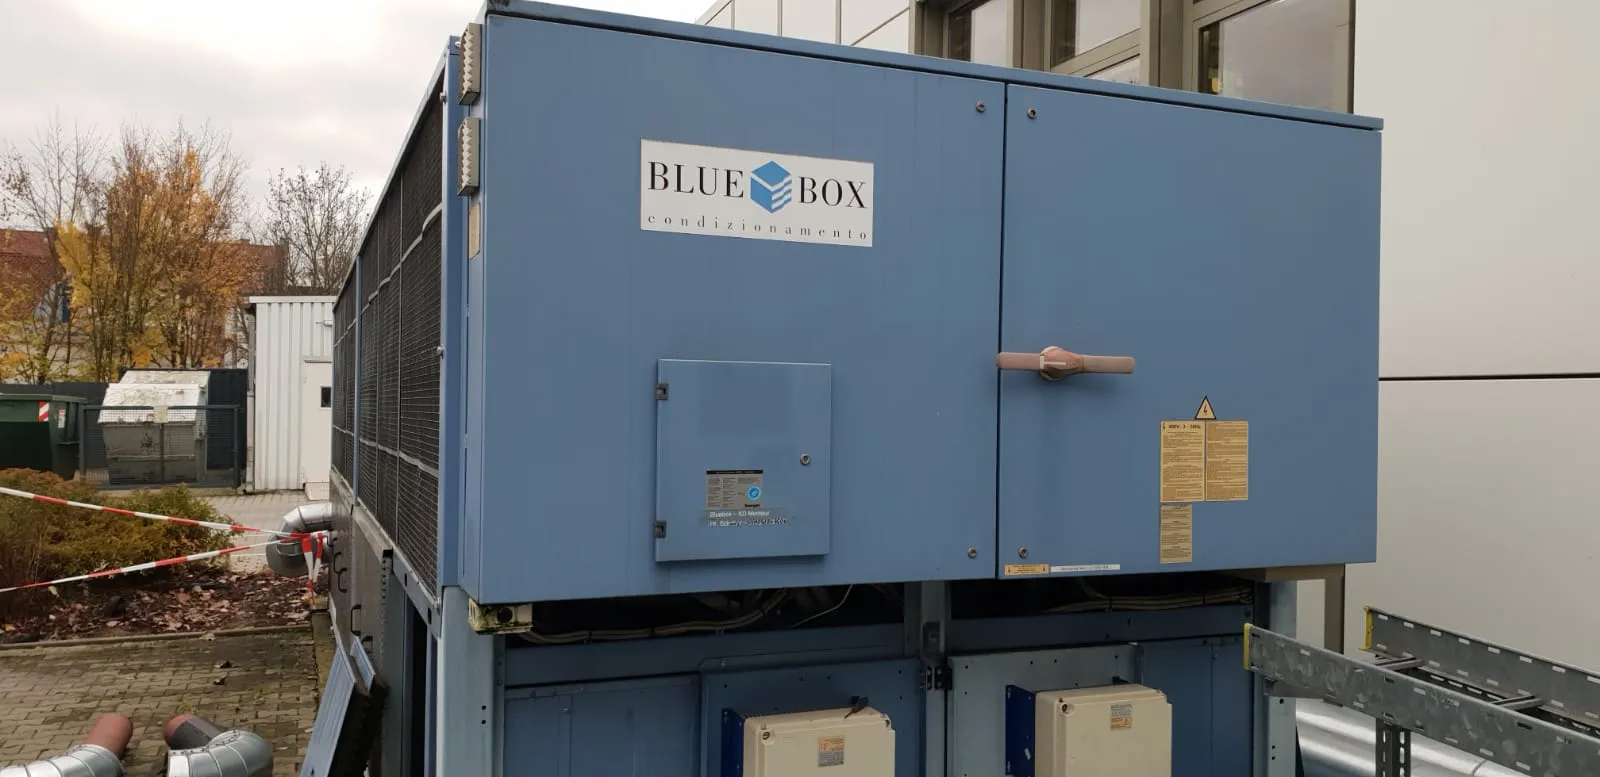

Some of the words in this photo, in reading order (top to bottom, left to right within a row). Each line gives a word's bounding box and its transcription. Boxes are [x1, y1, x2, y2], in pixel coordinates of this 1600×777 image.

[648, 161, 744, 198] BLUE
[798, 176, 868, 209] BOX
[648, 215, 867, 240] condizionamento
